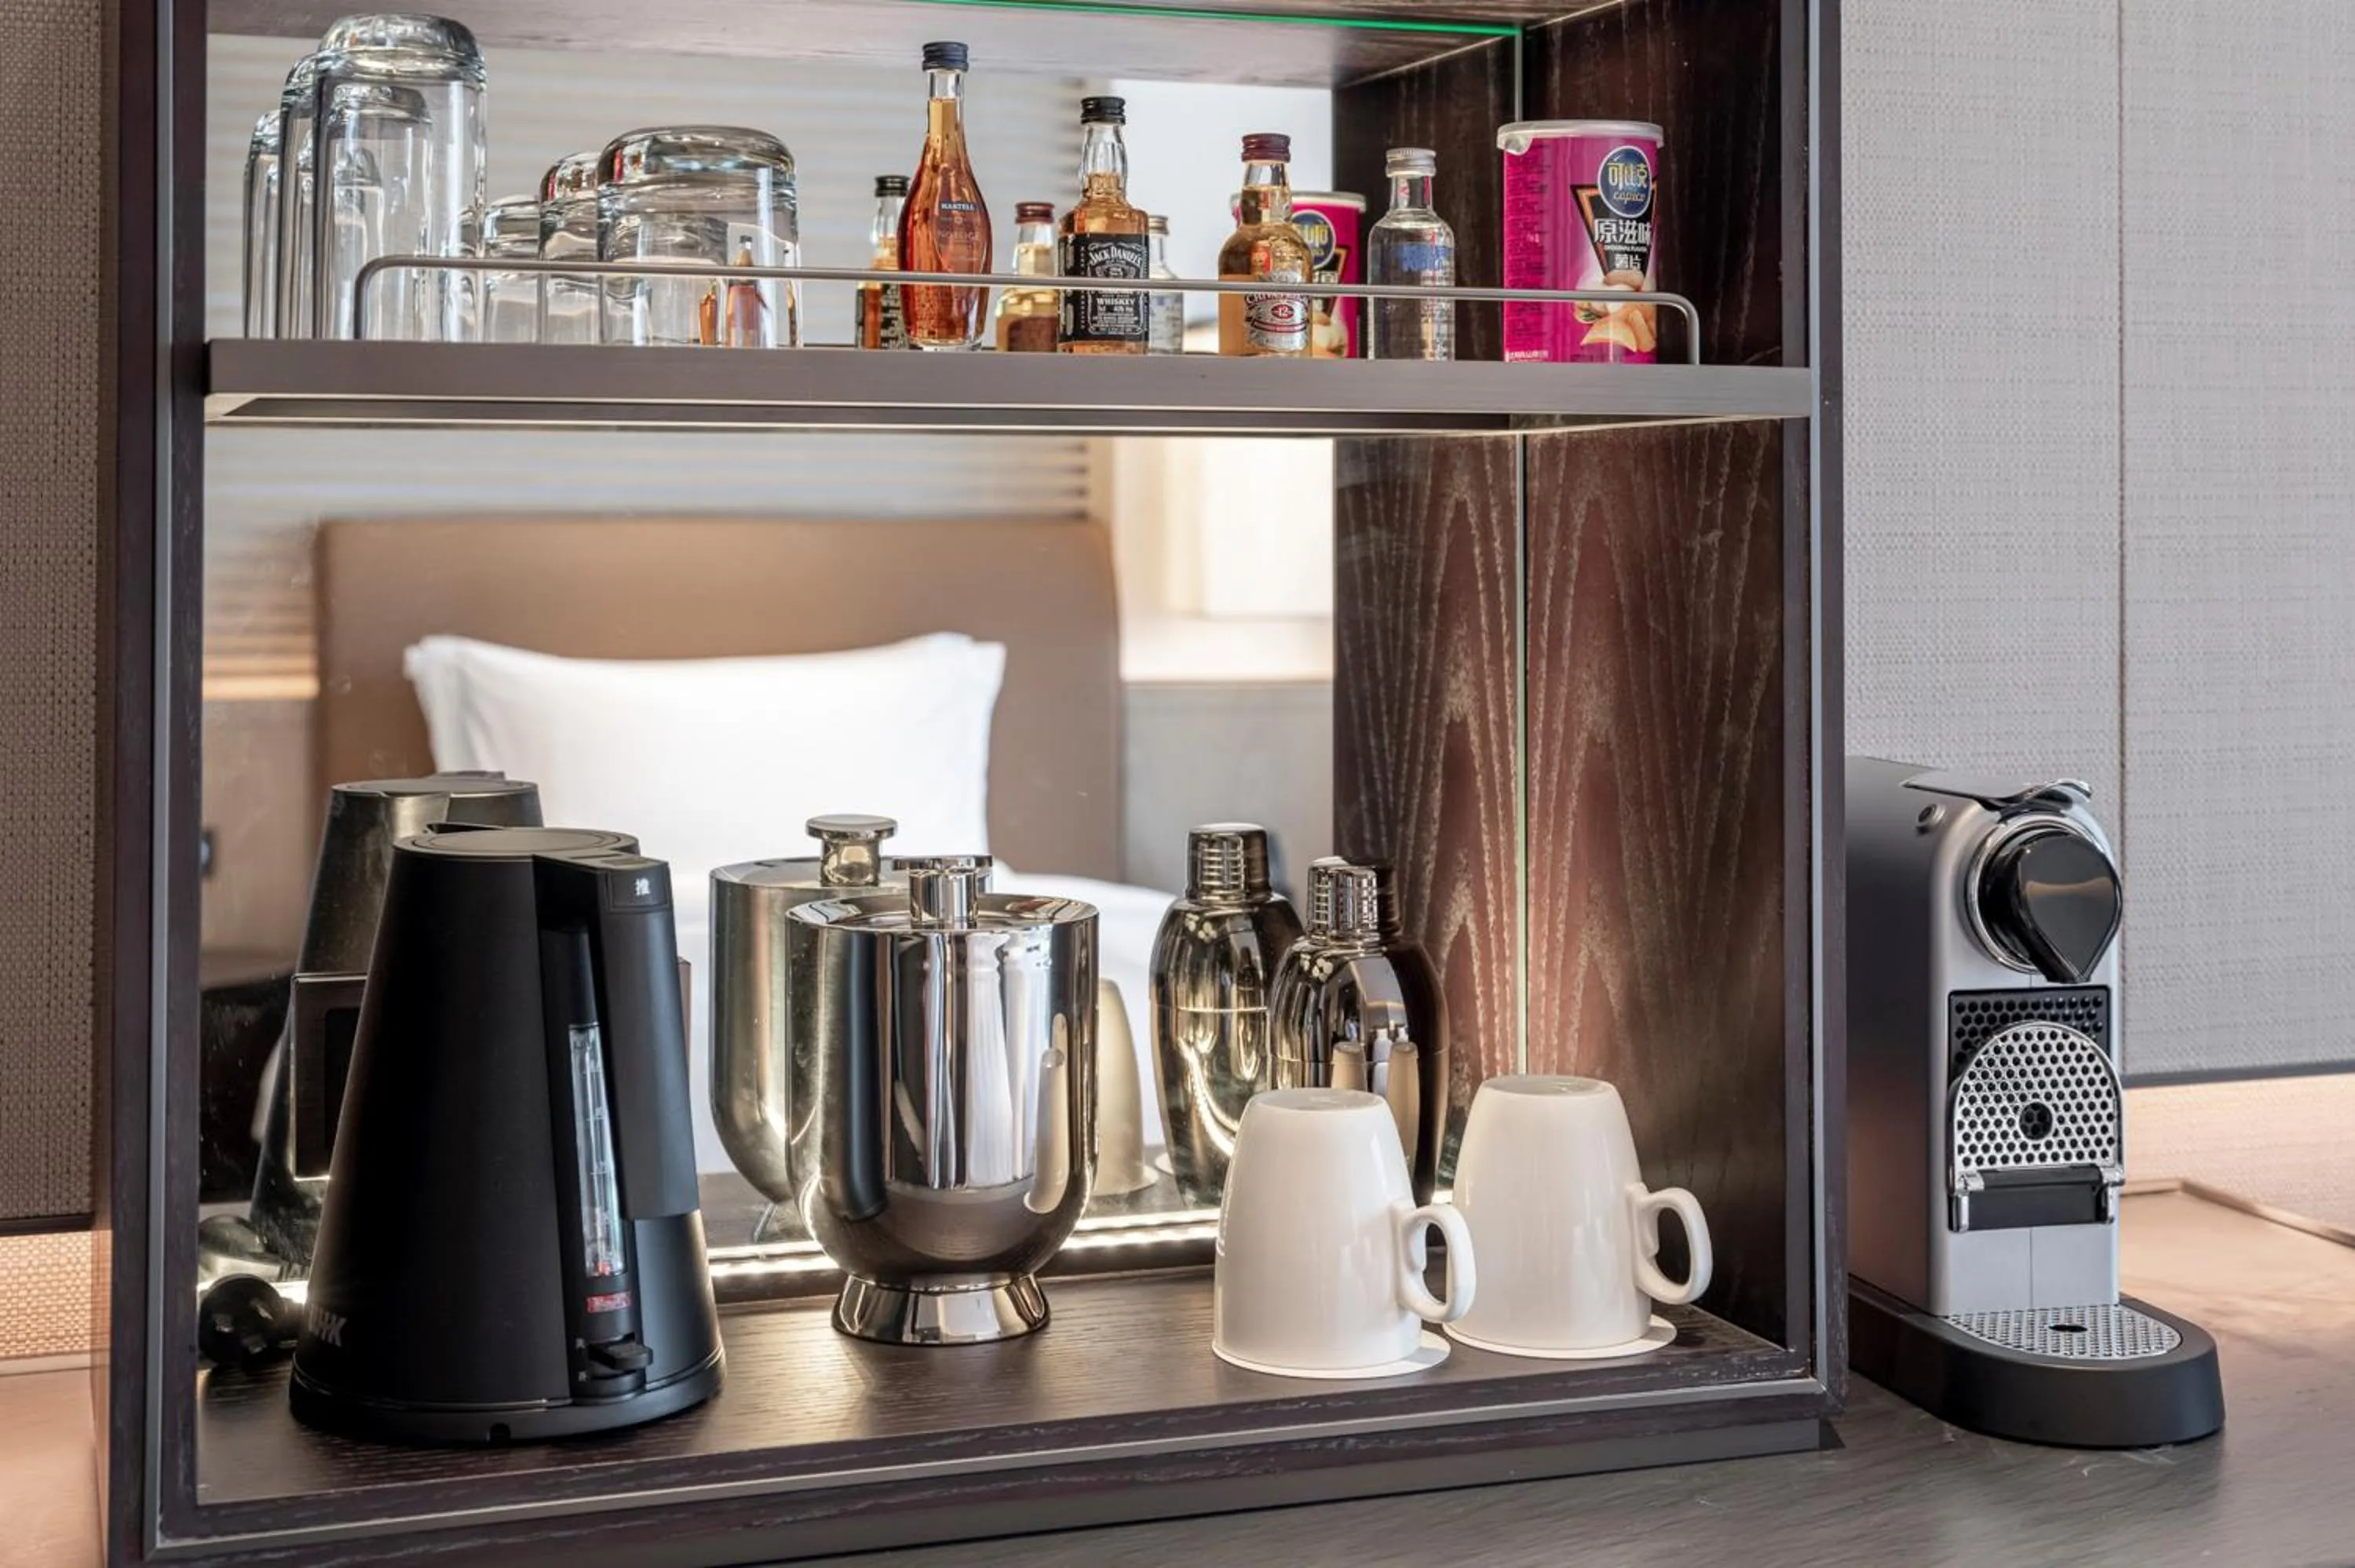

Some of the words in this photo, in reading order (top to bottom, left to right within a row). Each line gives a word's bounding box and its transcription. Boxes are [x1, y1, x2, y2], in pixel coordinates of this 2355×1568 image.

[1608, 162, 1648, 190] 可比克
[1594, 218, 1652, 246] 原滋味
[1089, 250, 1111, 267] JACK
